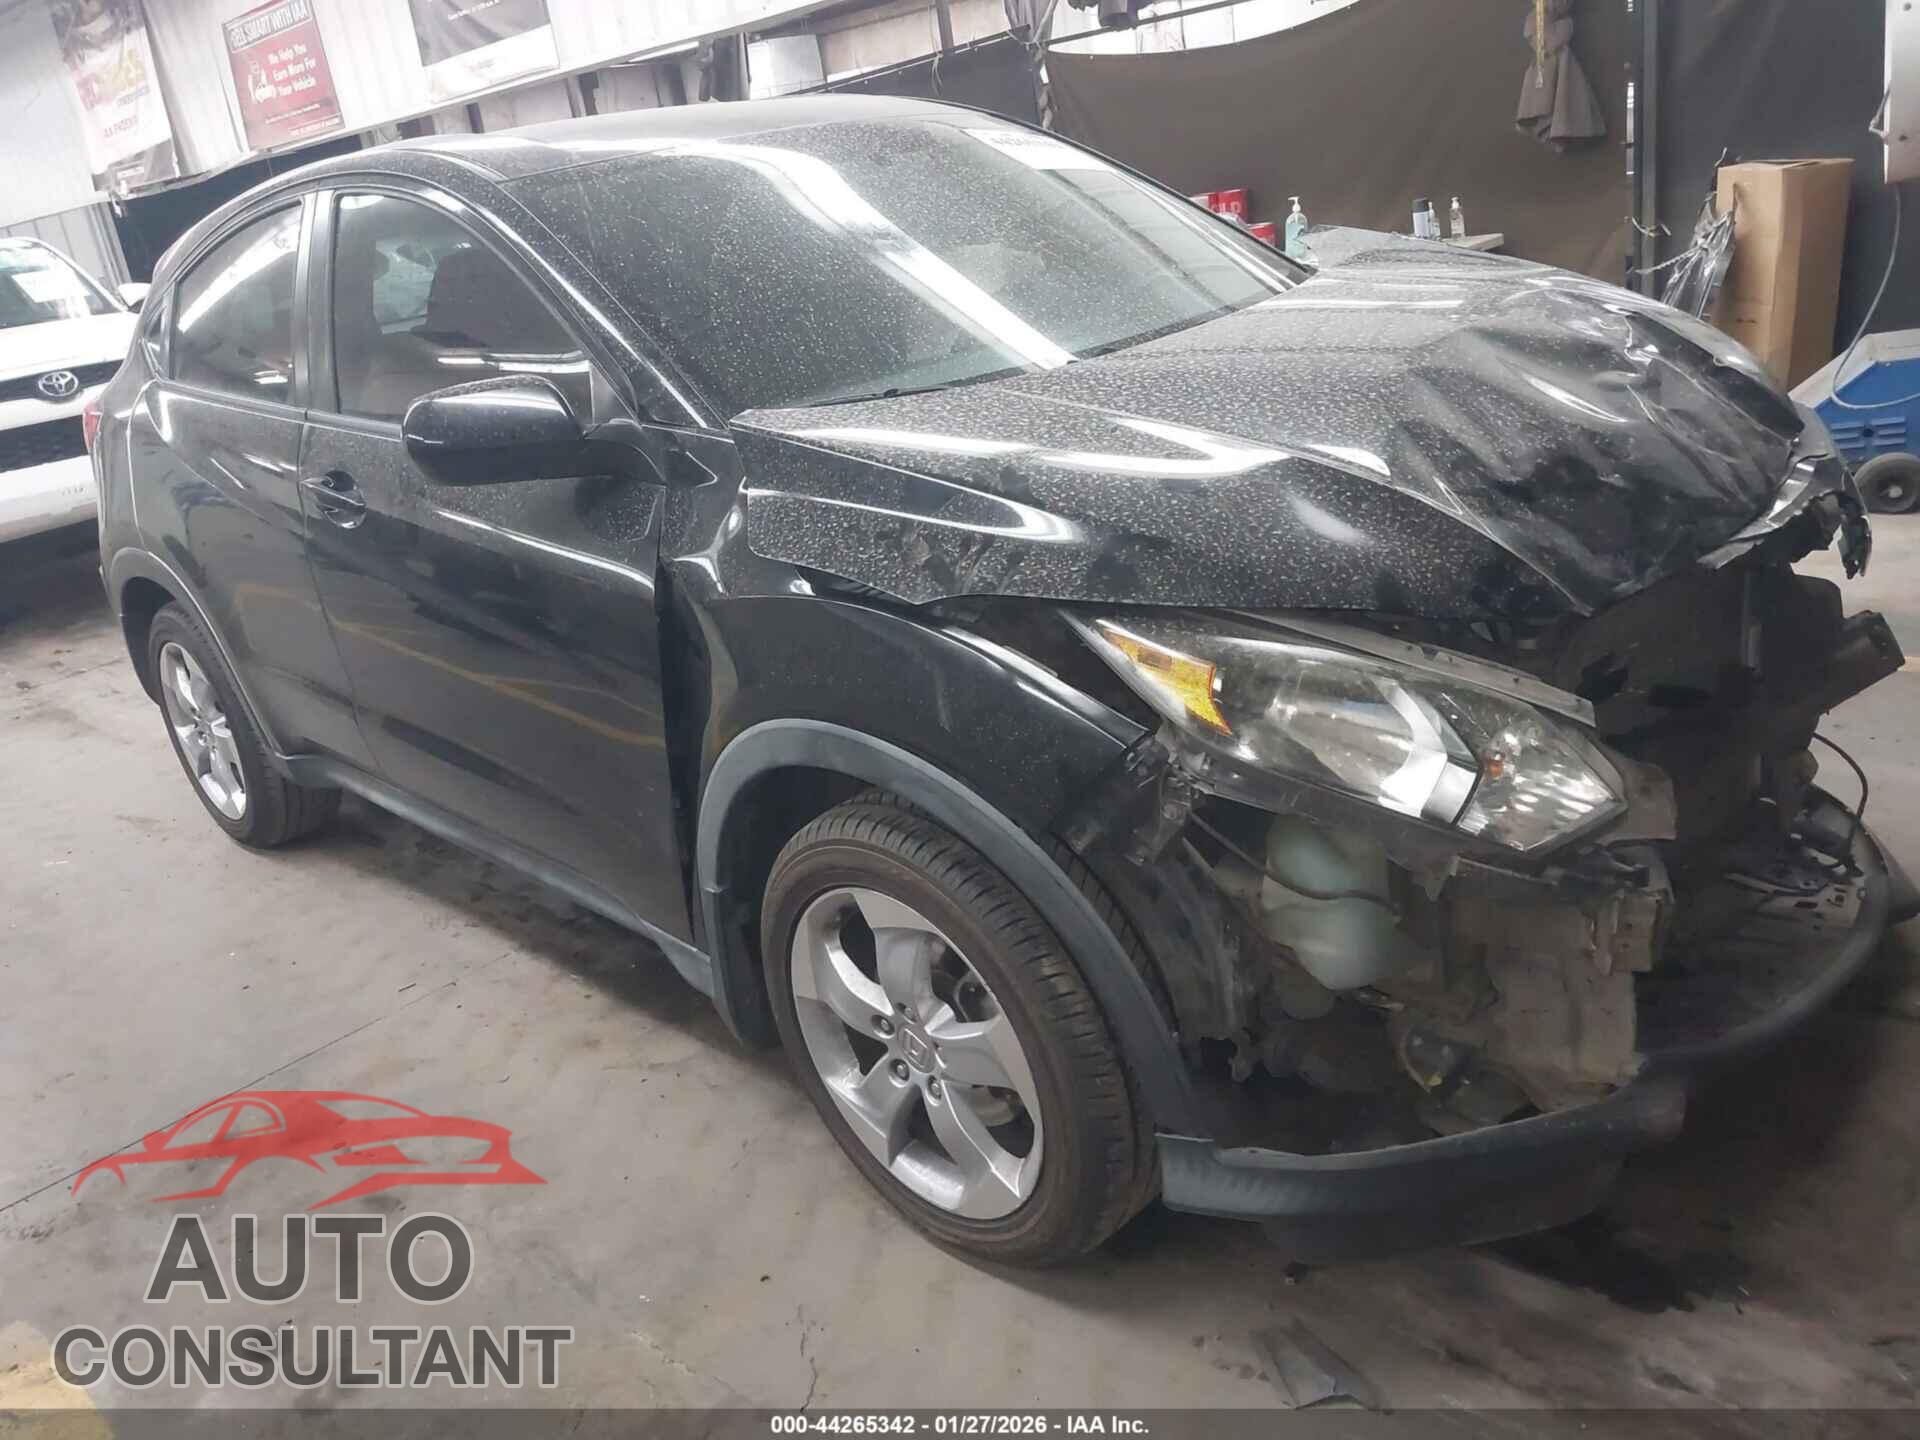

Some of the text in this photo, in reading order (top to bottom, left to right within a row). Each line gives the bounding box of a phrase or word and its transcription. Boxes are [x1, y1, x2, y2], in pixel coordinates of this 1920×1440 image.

[270, 6, 294, 33] WITH
[278, 47, 294, 61] Help
[287, 63, 305, 76] More
[303, 57, 317, 70] For
